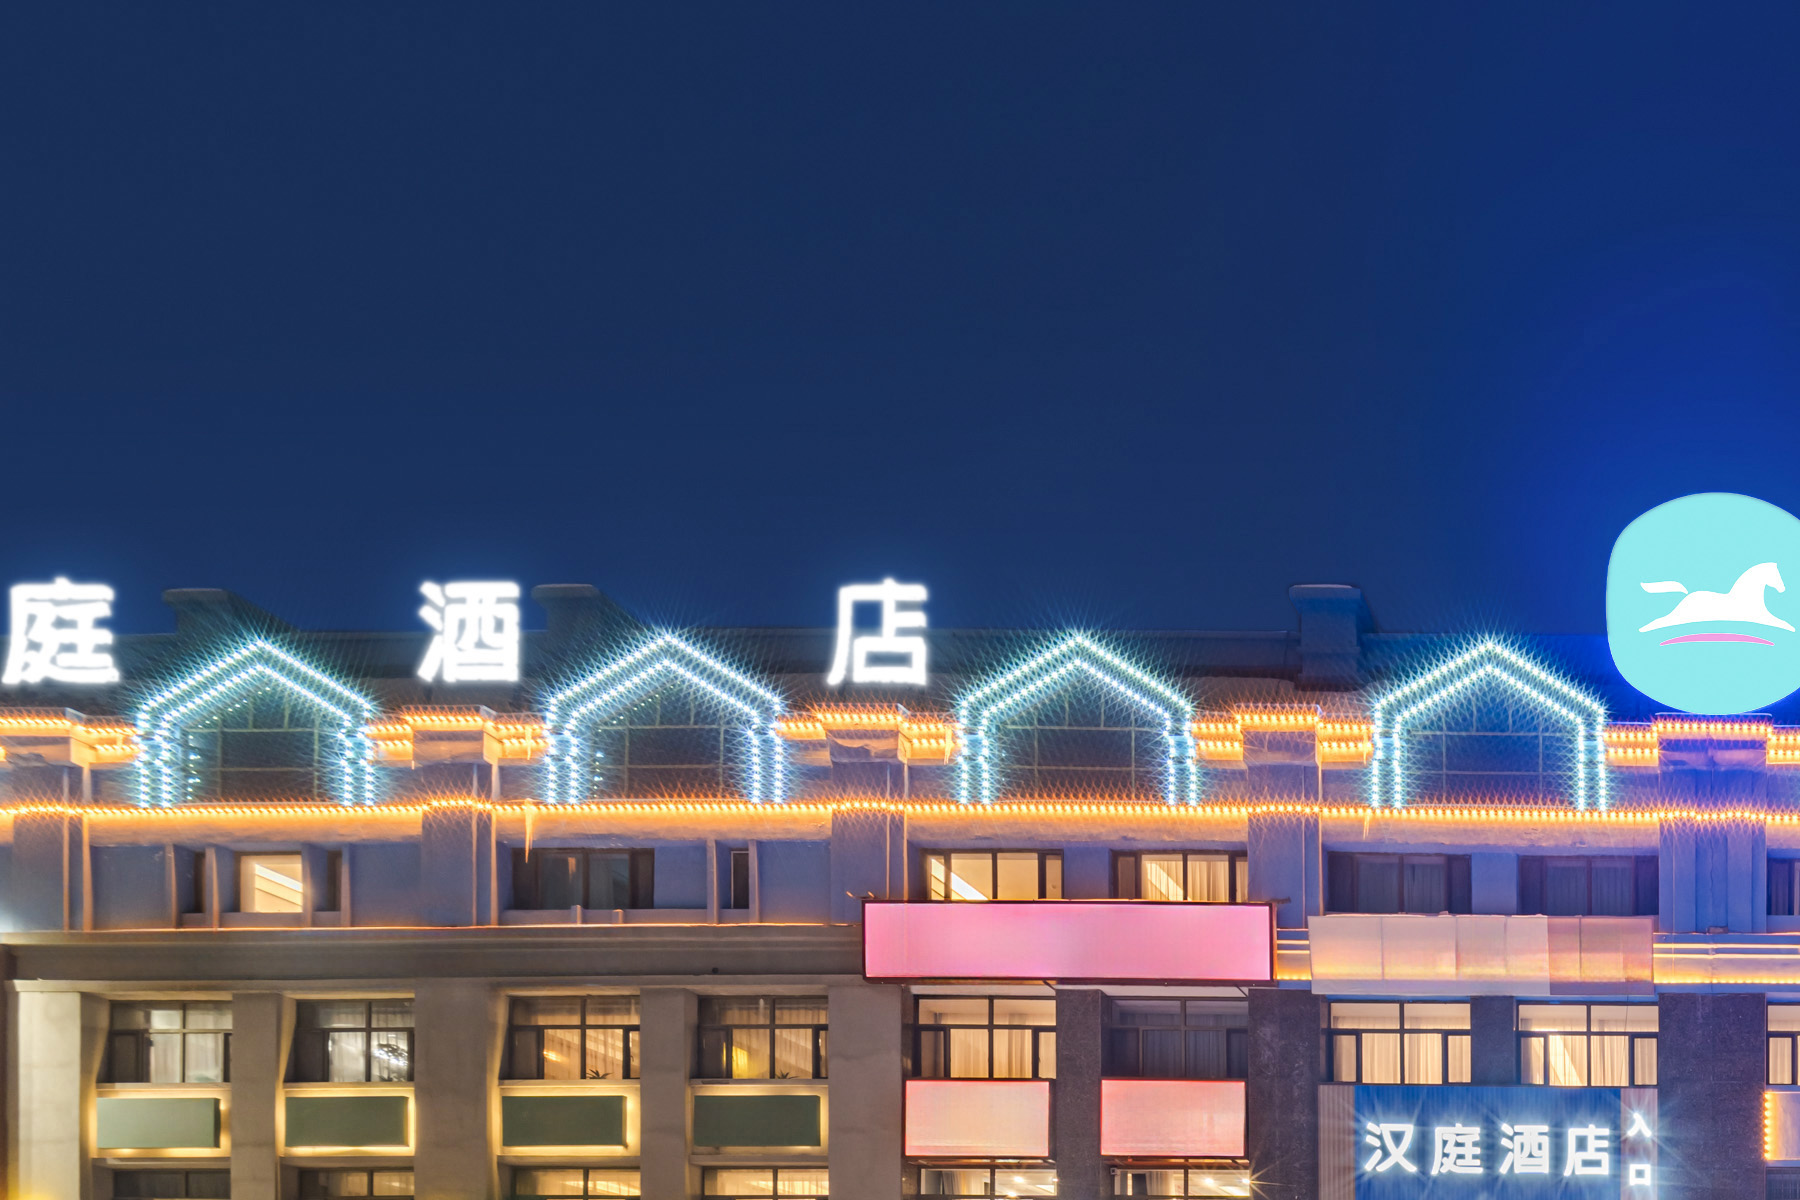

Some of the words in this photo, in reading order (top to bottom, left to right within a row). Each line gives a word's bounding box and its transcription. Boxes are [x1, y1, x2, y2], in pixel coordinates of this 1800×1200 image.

[2, 577, 928, 685] 庭酒店
[1363, 1122, 1611, 1177] 汉庭酒店
[1627, 1112, 1653, 1187] 入口
